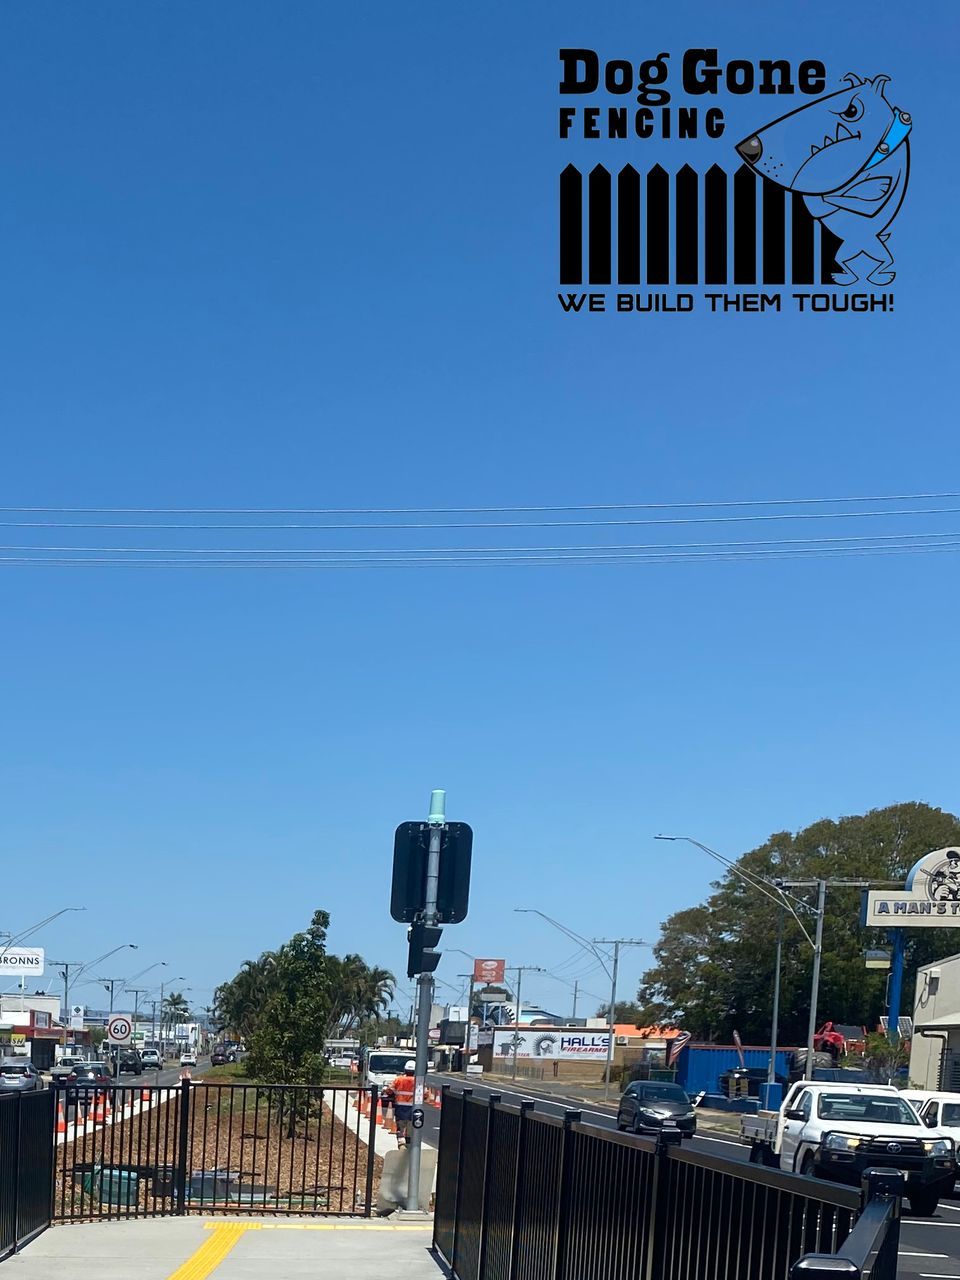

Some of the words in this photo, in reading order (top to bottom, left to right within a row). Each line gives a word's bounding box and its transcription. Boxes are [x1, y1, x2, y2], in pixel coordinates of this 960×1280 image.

[878, 902, 890, 914] A
[894, 902, 947, 915] MAN'S
[112, 1024, 128, 1035] 60
[560, 1036, 610, 1049] HALL'S
